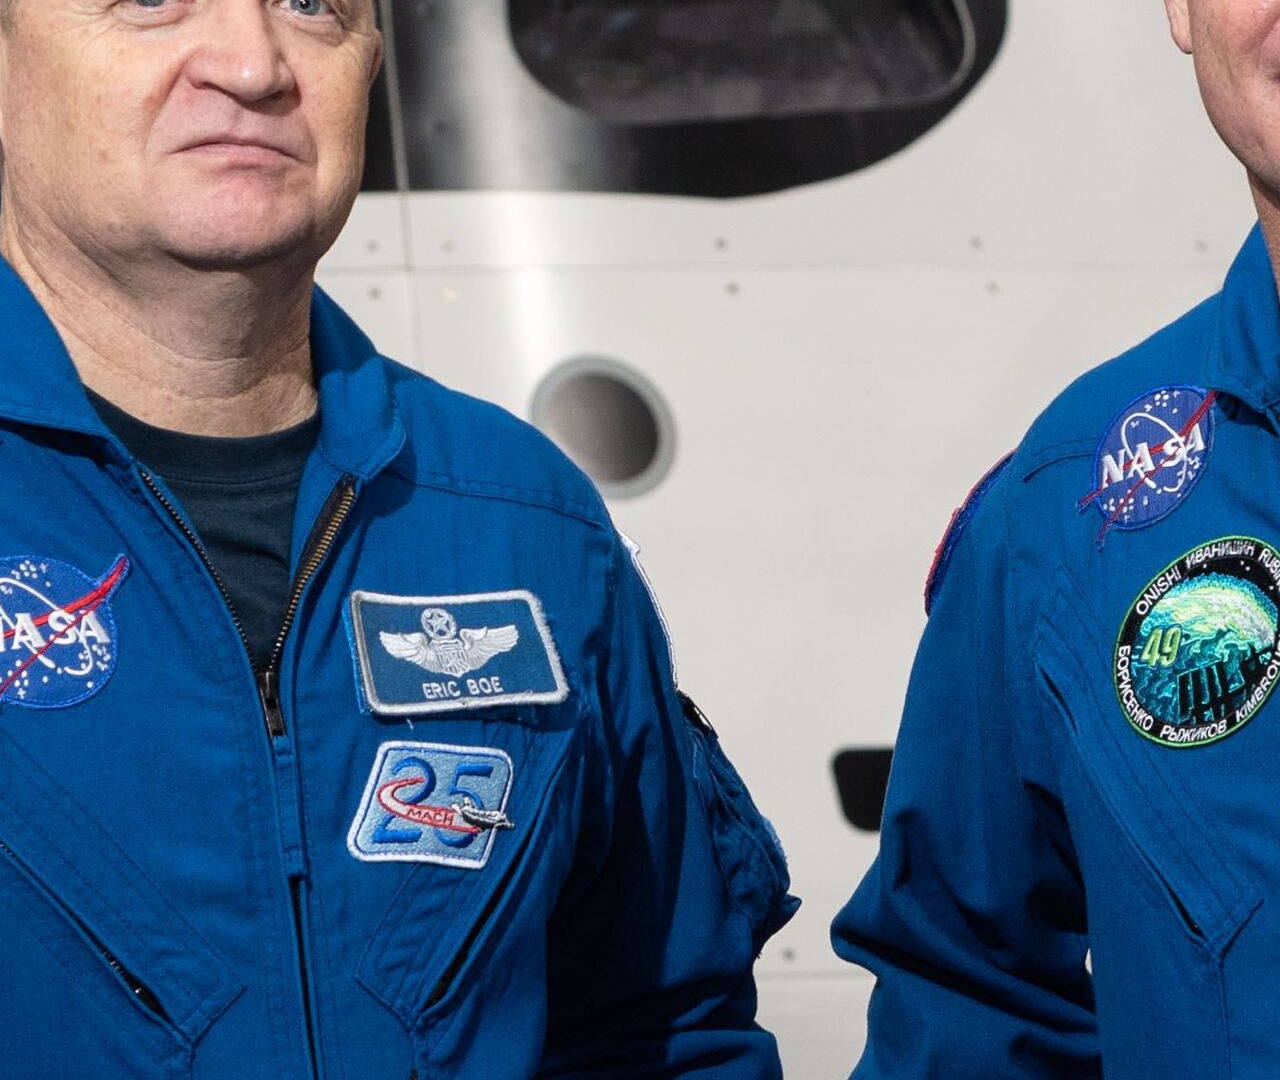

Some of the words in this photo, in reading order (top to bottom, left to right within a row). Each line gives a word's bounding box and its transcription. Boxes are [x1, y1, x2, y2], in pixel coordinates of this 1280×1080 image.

[1101, 423, 1206, 489] NASA
[1185, 540, 1256, 569] ИВАНИШИН
[1136, 565, 1182, 615] ONISHI
[1140, 626, 1183, 667] 49
[422, 680, 461, 700] ERIC
[466, 676, 504, 696] BOE
[1116, 645, 1154, 731] БОРИСЕНКО
[1160, 719, 1228, 742] РЫЖИКОВ
[371, 756, 494, 849] 25
[405, 807, 455, 826] MACH
